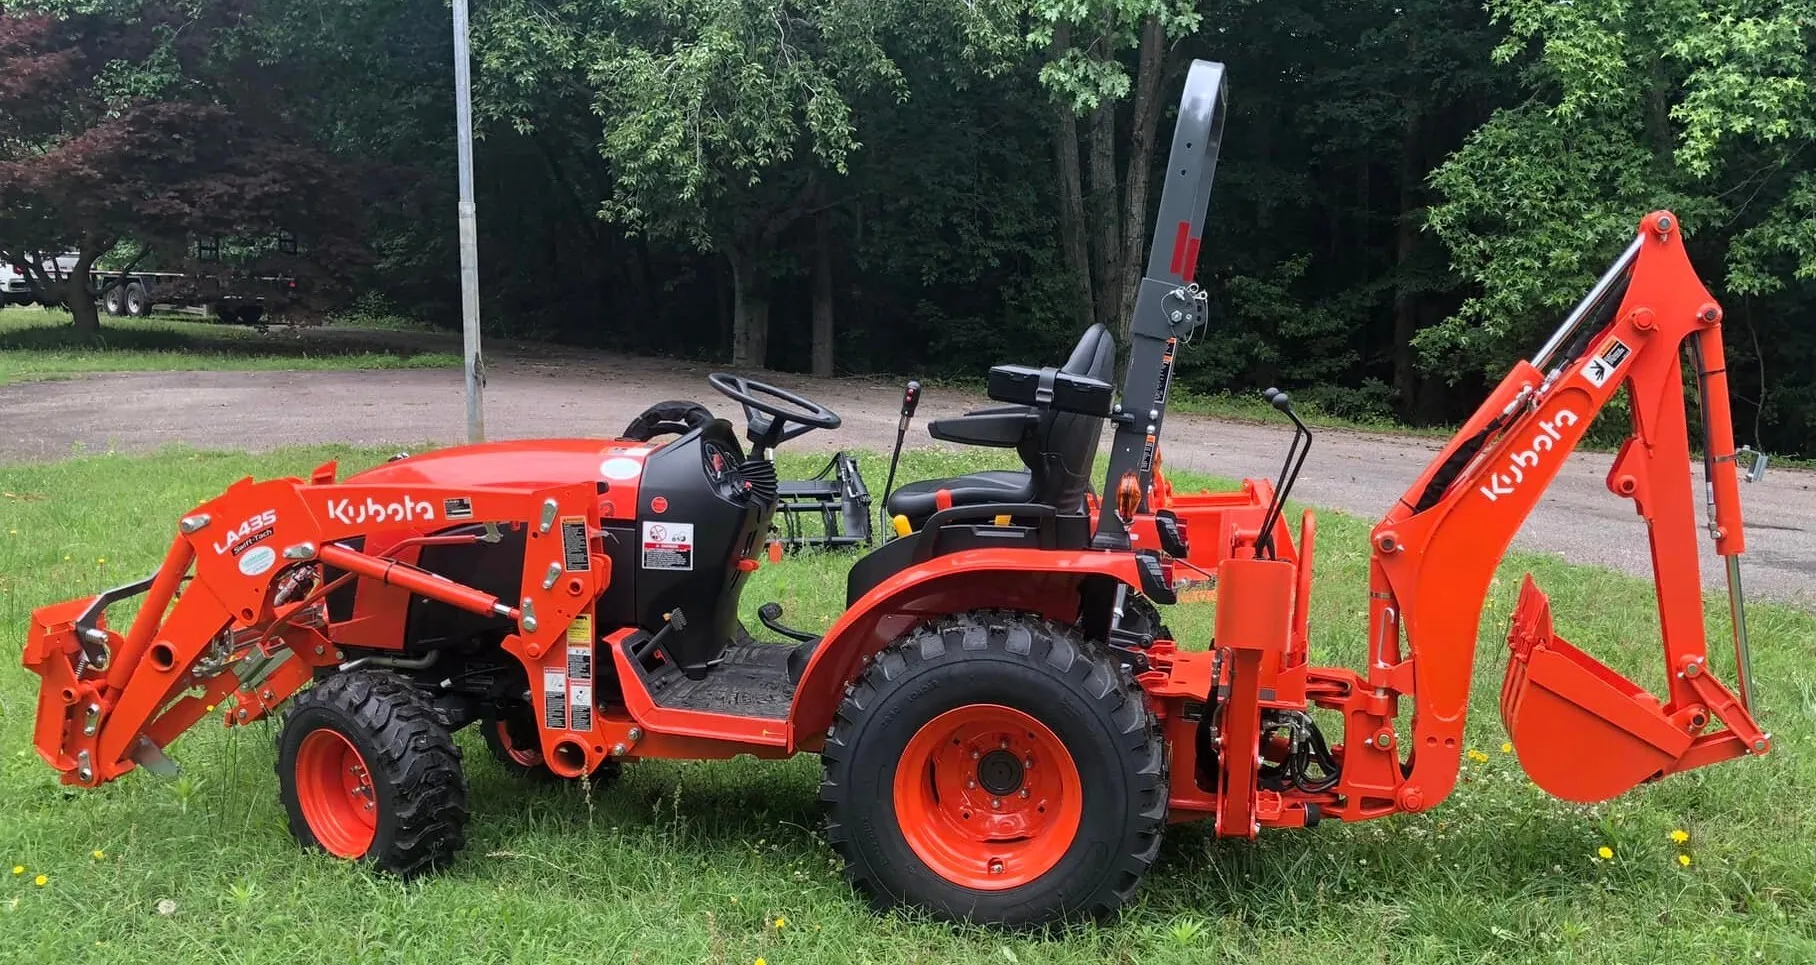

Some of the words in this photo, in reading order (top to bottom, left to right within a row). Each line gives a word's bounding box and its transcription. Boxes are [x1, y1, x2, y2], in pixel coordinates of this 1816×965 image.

[1480, 410, 1578, 501] Kubota
[213, 509, 277, 555] LA435
[327, 495, 434, 524] Kubota
